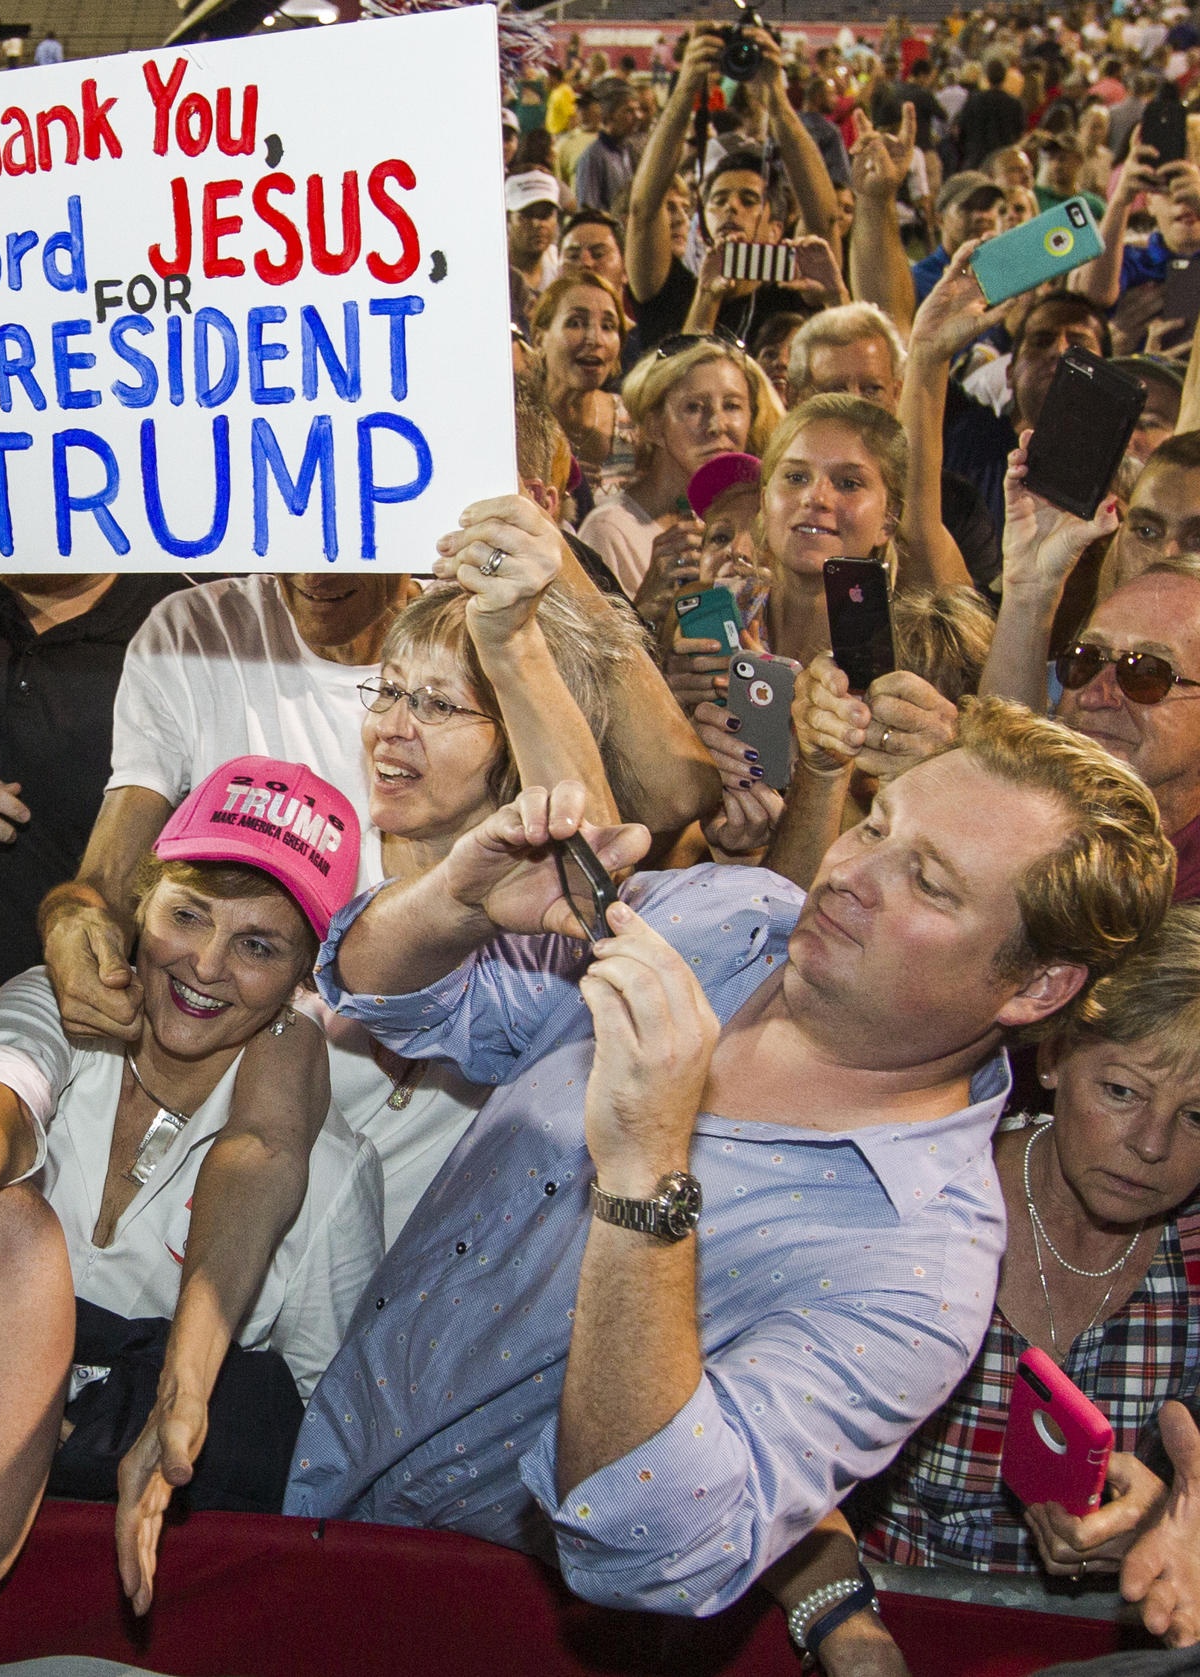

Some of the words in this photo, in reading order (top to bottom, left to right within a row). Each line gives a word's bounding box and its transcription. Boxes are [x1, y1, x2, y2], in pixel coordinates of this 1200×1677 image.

[143, 58, 285, 169] You,
[148, 159, 448, 285] JESUS,
[94, 274, 192, 323] FOR
[210, 811, 239, 825] MAKE
[237, 815, 282, 840] AMERICA
[282, 831, 310, 856] GREAT
[308, 850, 331, 877] AGAIN
[222, 783, 342, 854] TRUMP
